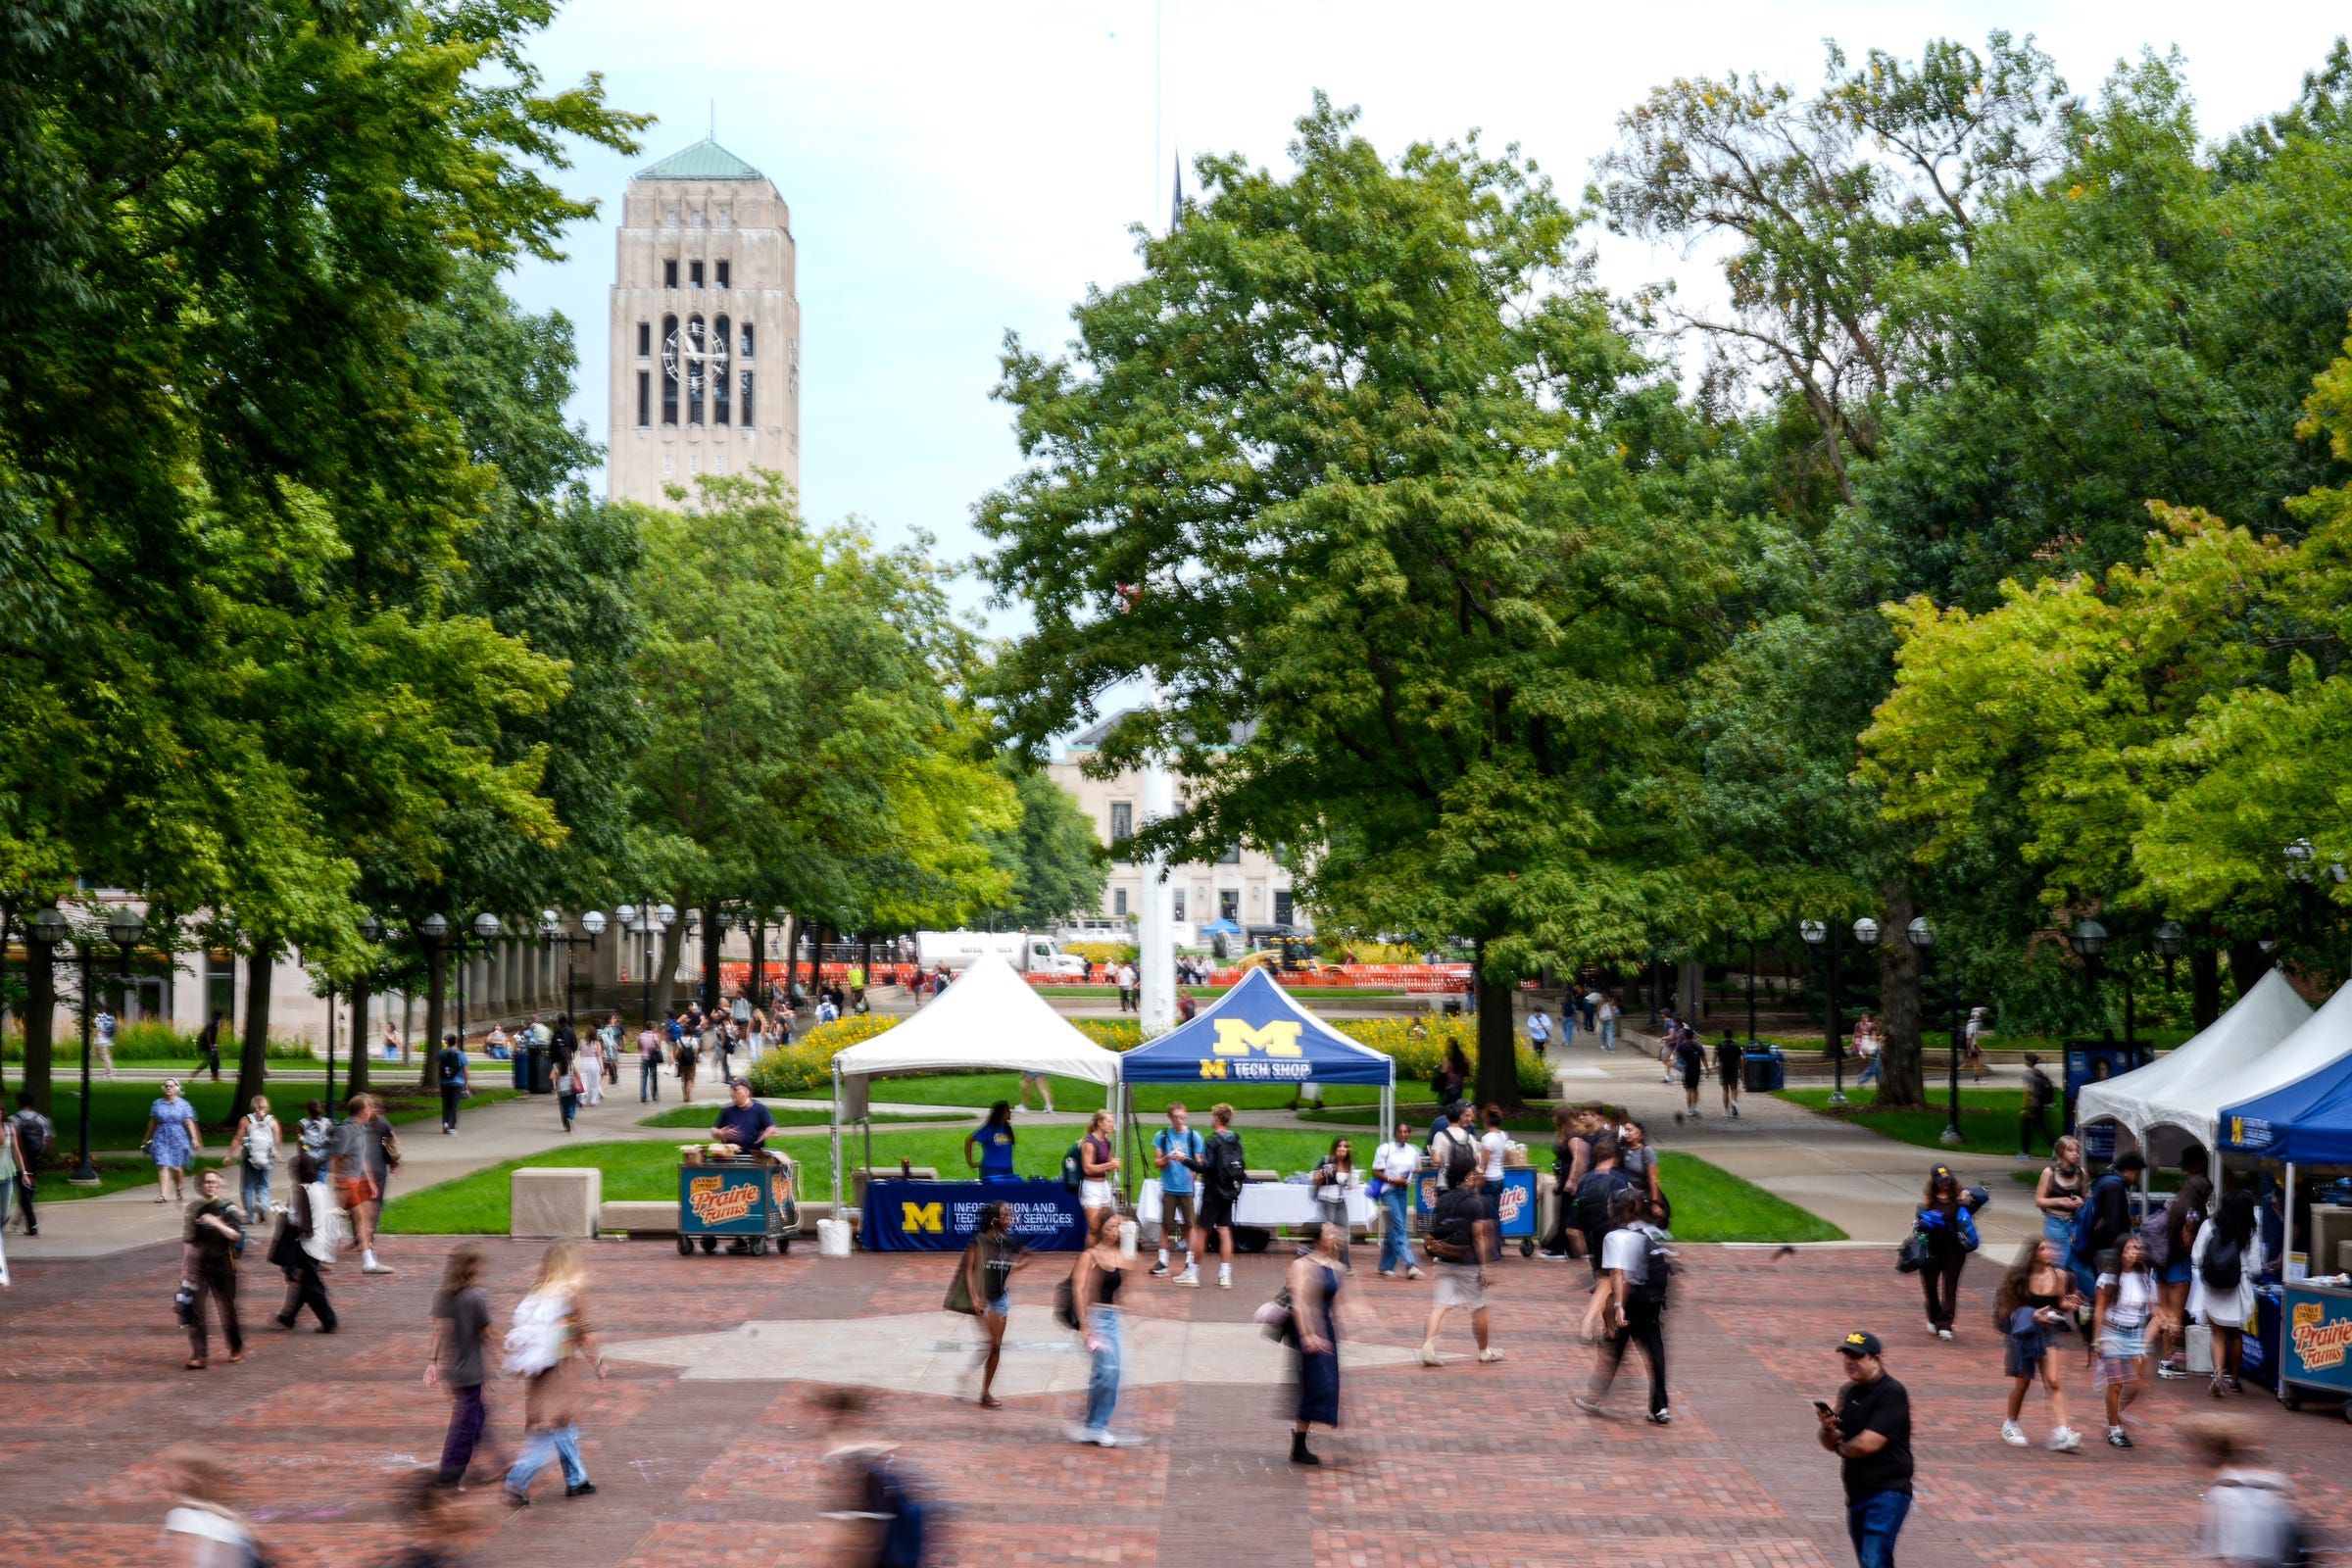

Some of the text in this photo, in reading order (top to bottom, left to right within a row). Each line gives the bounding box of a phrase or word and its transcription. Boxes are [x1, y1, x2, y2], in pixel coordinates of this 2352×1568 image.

[1213, 1018, 1303, 1057] M
[1200, 1058, 1311, 1079] M TECH SHOP
[690, 1184, 759, 1213] Prairie
[1032, 1202, 1057, 1212] AND
[701, 1204, 747, 1223] Farms
[902, 1201, 943, 1233] M
[1023, 1213, 1073, 1225] SERVICES
[1015, 1224, 1056, 1233] MICHIGAN
[2292, 1318, 2352, 1351] Prairie
[2302, 1347, 2342, 1368] Farms
